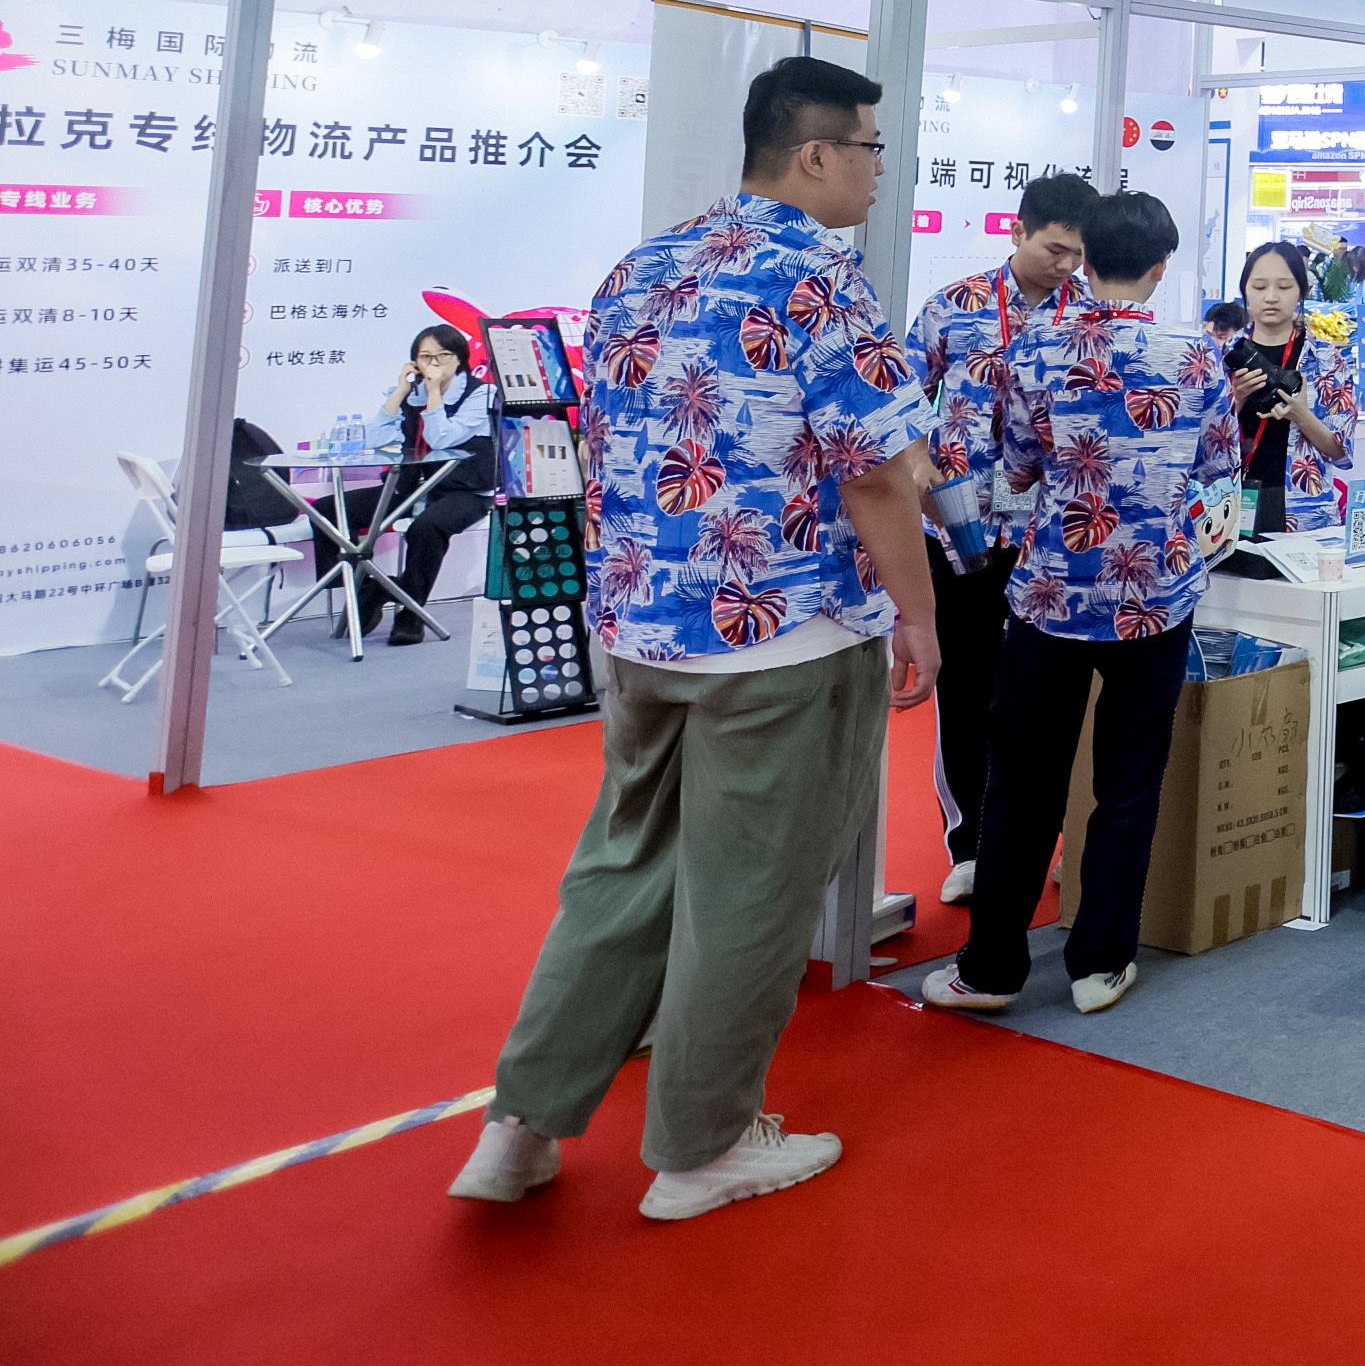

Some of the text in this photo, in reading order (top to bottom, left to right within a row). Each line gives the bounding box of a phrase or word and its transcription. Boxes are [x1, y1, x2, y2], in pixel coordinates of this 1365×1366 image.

[51, 58, 180, 83] SUNMAY
[1312, 152, 1349, 160] amazon
[304, 197, 385, 216] 核心优势
[273, 258, 353, 274] 派送到门
[270, 303, 389, 321] 巴格达海外仓
[0, 353, 154, 374] 集运45-50天
[266, 350, 347, 368] 代收货款
